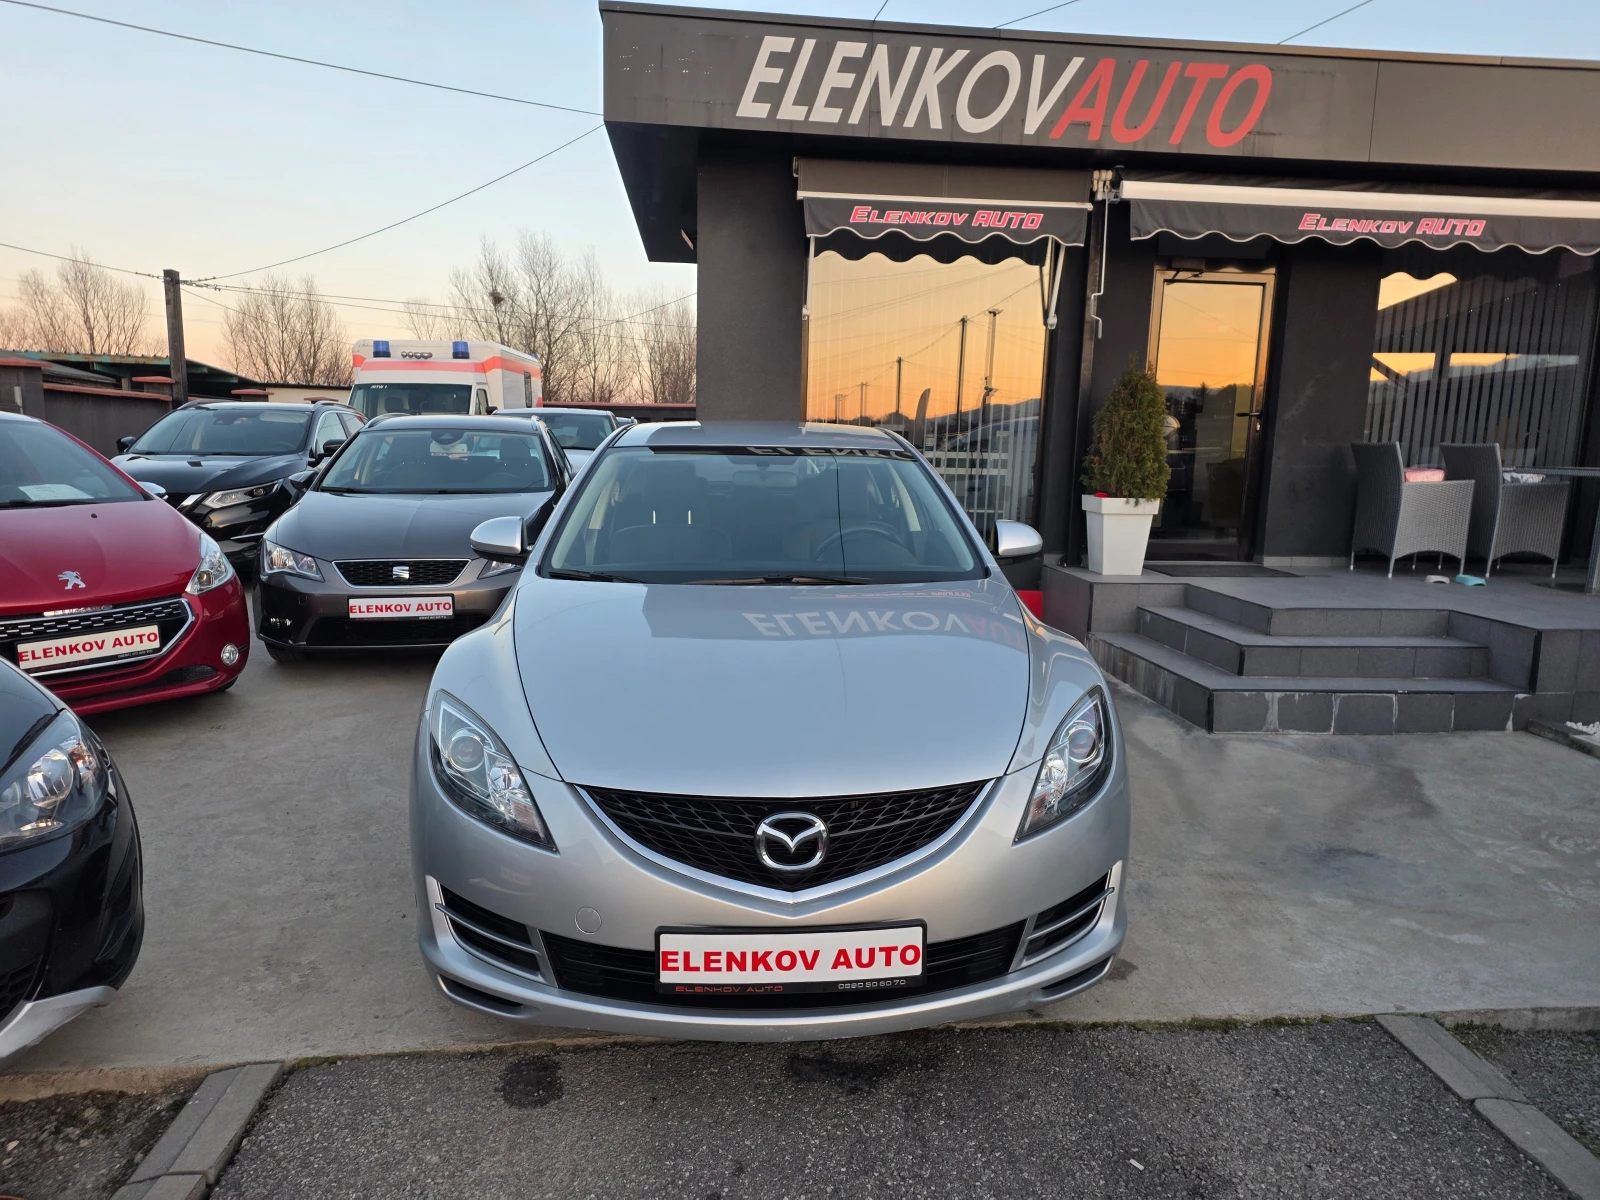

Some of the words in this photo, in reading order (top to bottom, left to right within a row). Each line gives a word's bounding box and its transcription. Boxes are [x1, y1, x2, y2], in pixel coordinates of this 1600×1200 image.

[850, 206, 969, 226] ELENKOV
[971, 210, 1044, 230] AUTO
[1298, 213, 1414, 234] ELENKOV
[1416, 217, 1487, 237] AUTO
[349, 603, 411, 614] ELENKOV
[416, 602, 452, 612] AUTO
[18, 639, 106, 663] ELENKOV
[111, 632, 158, 649] AUTO
[660, 950, 820, 973] ELENKOV
[831, 944, 921, 970] AUTO
